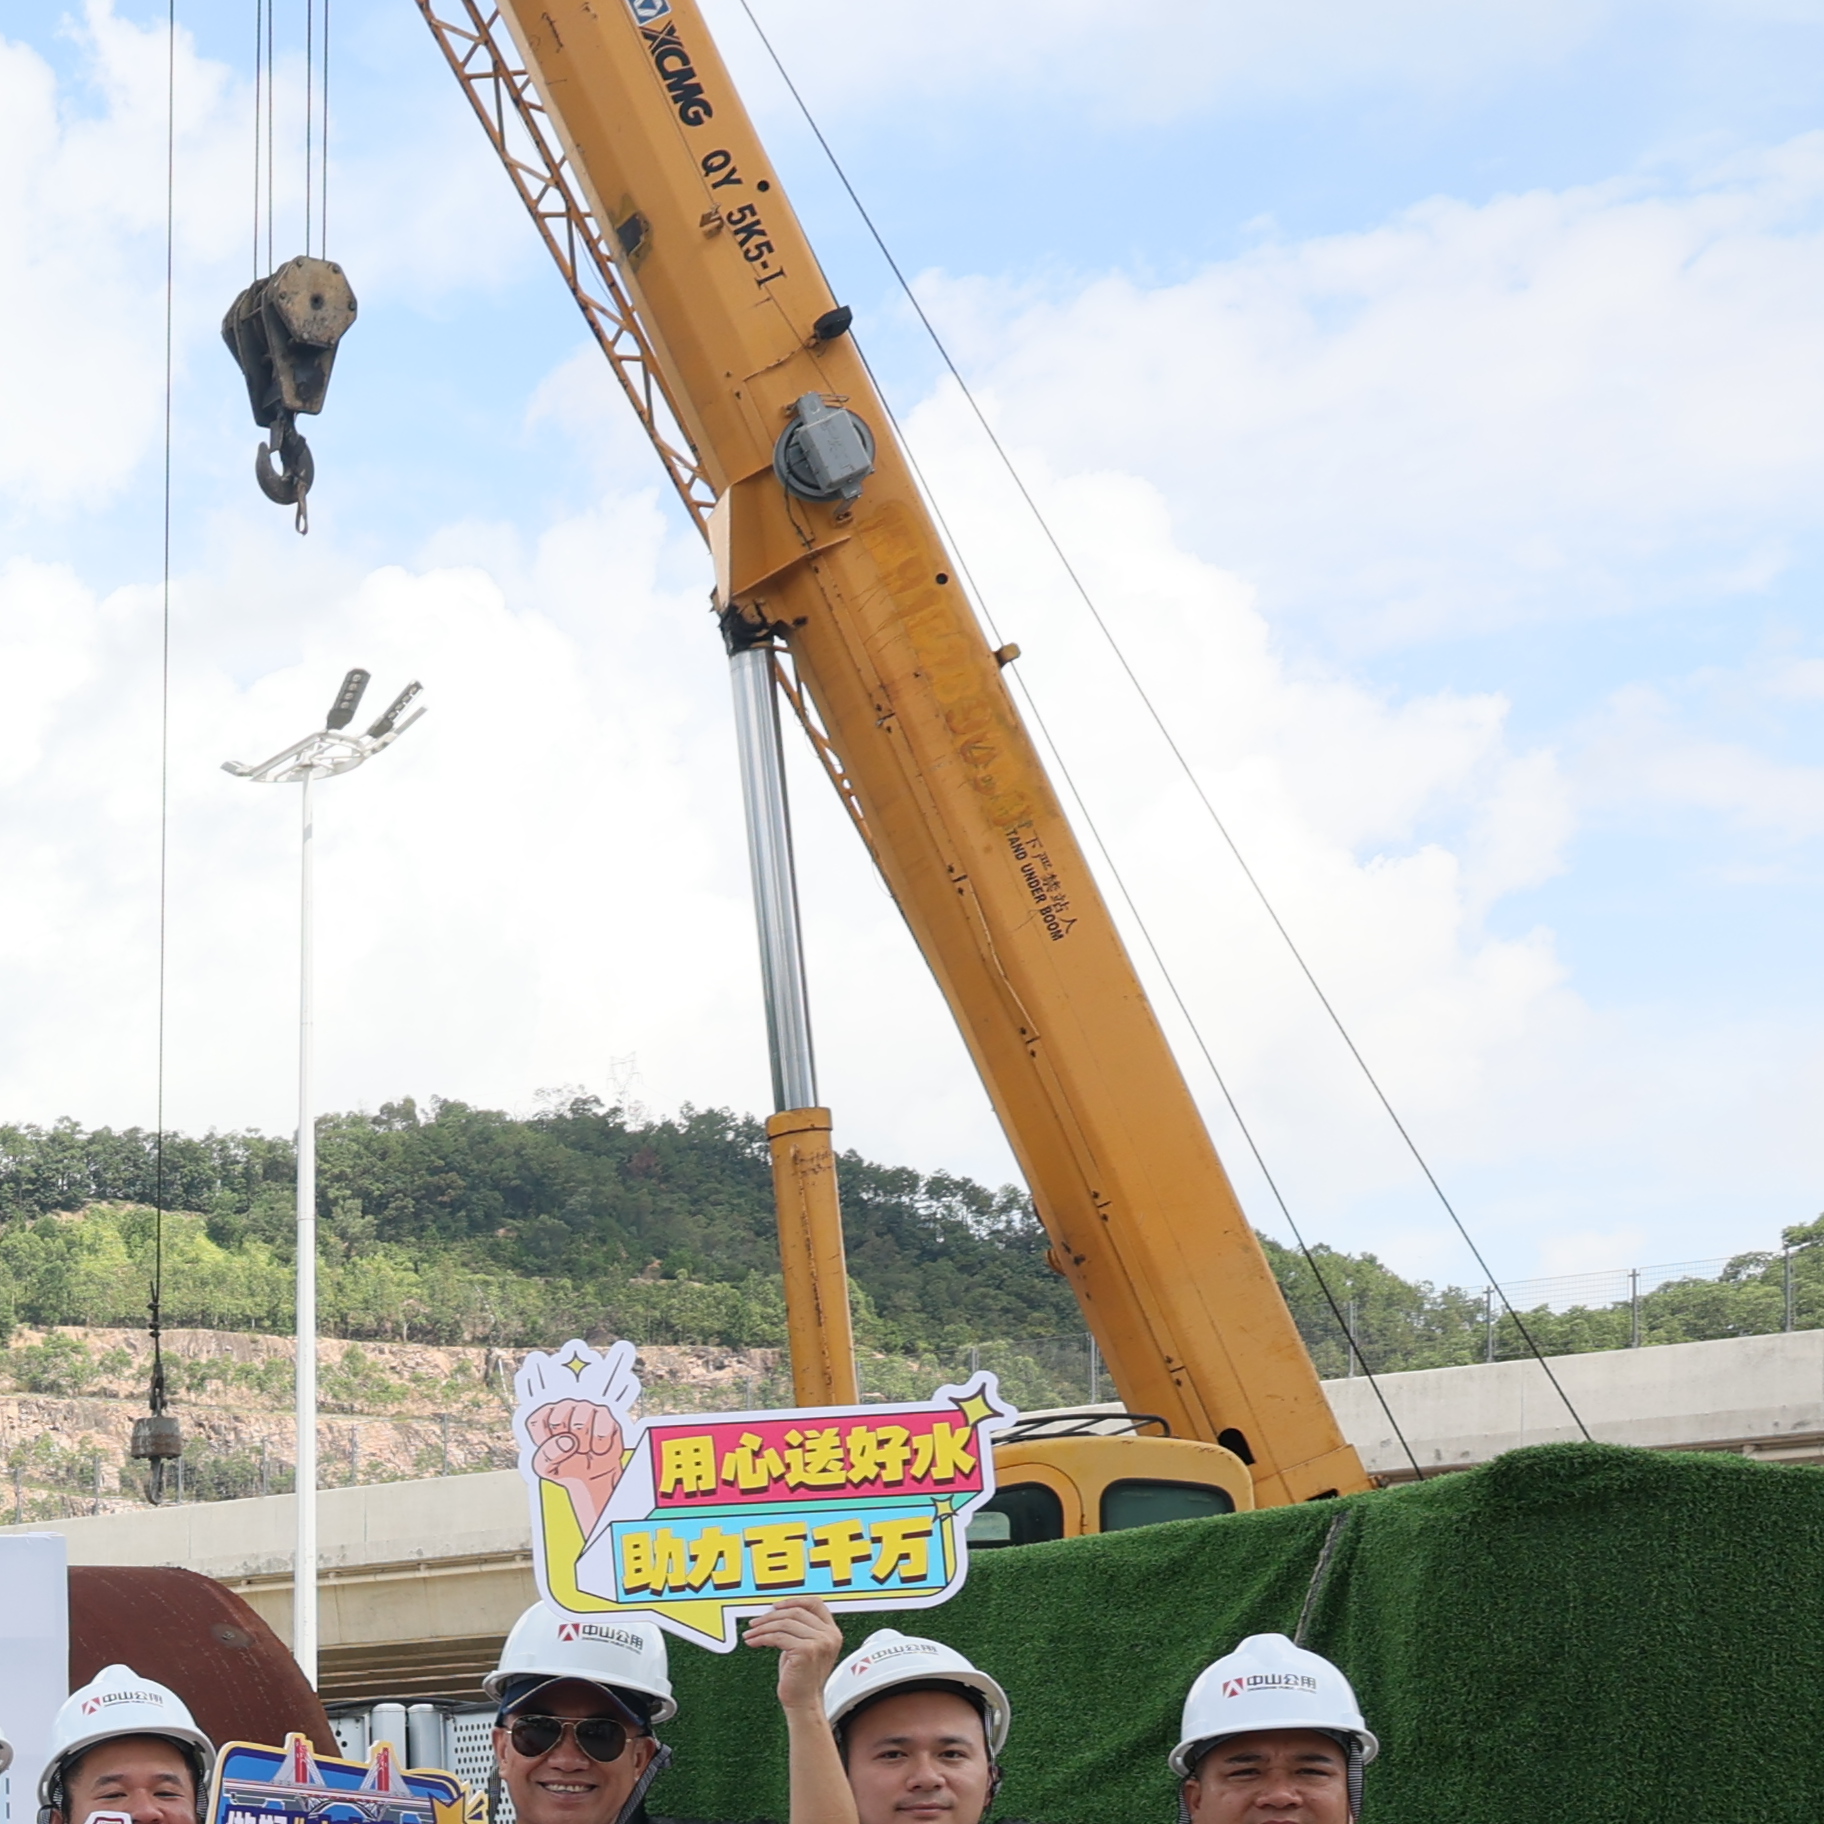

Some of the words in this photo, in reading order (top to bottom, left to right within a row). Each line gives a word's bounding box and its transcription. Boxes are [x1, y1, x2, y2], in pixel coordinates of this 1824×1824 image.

[639, 20, 713, 127] XCMG
[701, 149, 743, 190] QY
[1002, 825, 1028, 861] TAND
[1020, 862, 1048, 904] UNDER
[1040, 905, 1084, 941] BOOM
[659, 1426, 977, 1497] 用心送好水
[621, 1515, 933, 1597] 助力百千万
[582, 1624, 644, 1651] 中山公用
[102, 1691, 164, 1705] 中山公用
[1247, 1673, 1317, 1690] 中山公用
